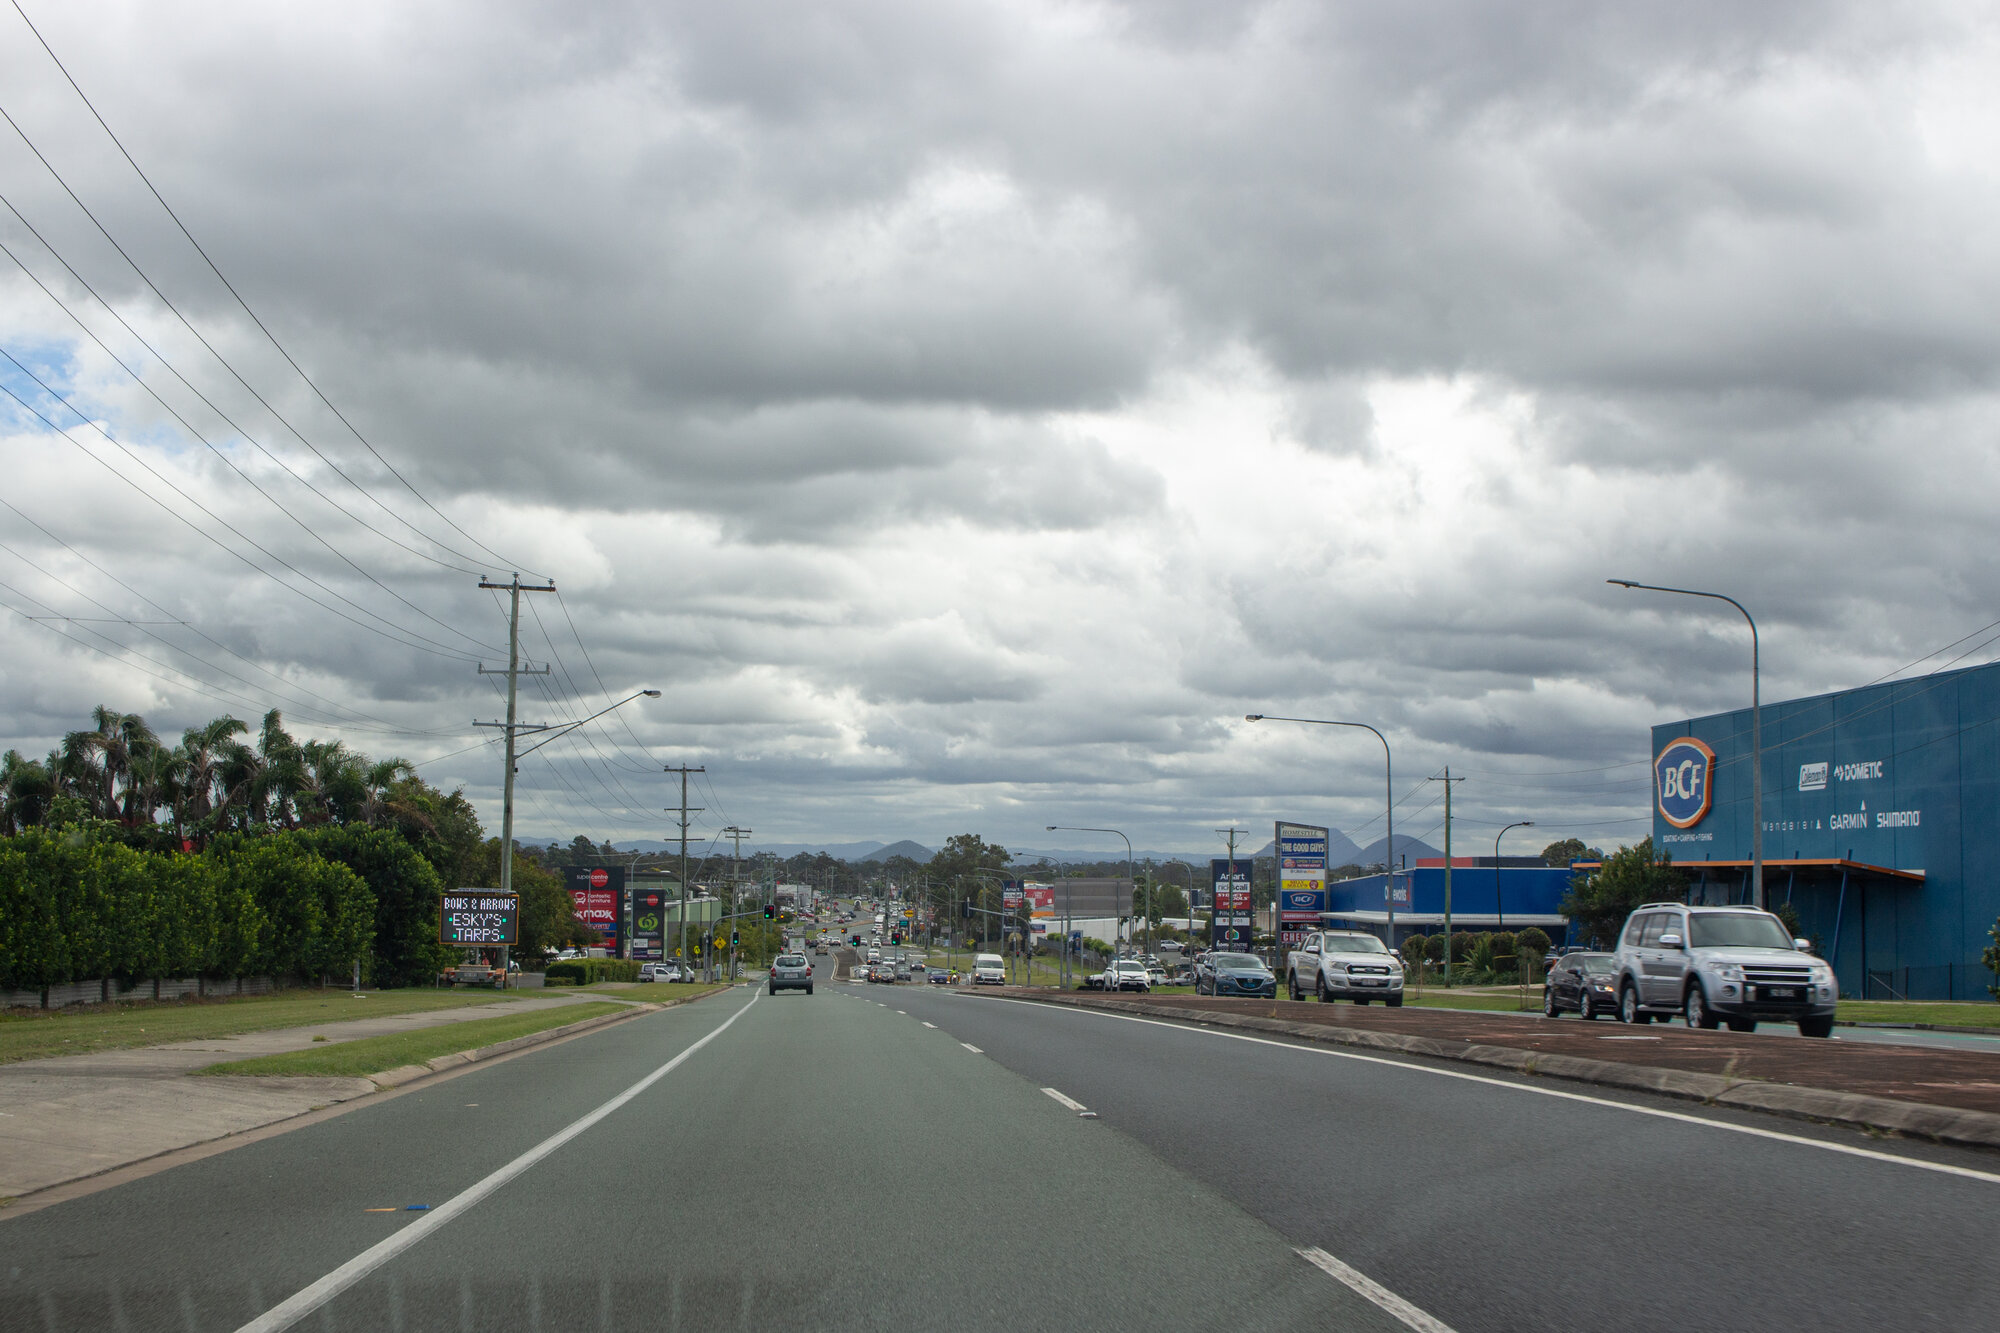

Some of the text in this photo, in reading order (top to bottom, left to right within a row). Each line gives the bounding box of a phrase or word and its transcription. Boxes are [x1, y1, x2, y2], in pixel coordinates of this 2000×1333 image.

[1845, 760, 1883, 782] DOMETIC
[1663, 759, 1702, 800] BCF
[1829, 812, 1868, 830] GARMIN
[1876, 810, 1920, 828] SHIMANO
[1282, 842, 1325, 853] THE GOOD GUYS
[444, 897, 516, 911] BOWS & ARROWS
[1294, 895, 1312, 903] BCF
[452, 912, 502, 927] ESKY'S
[455, 927, 500, 942] TARPS
